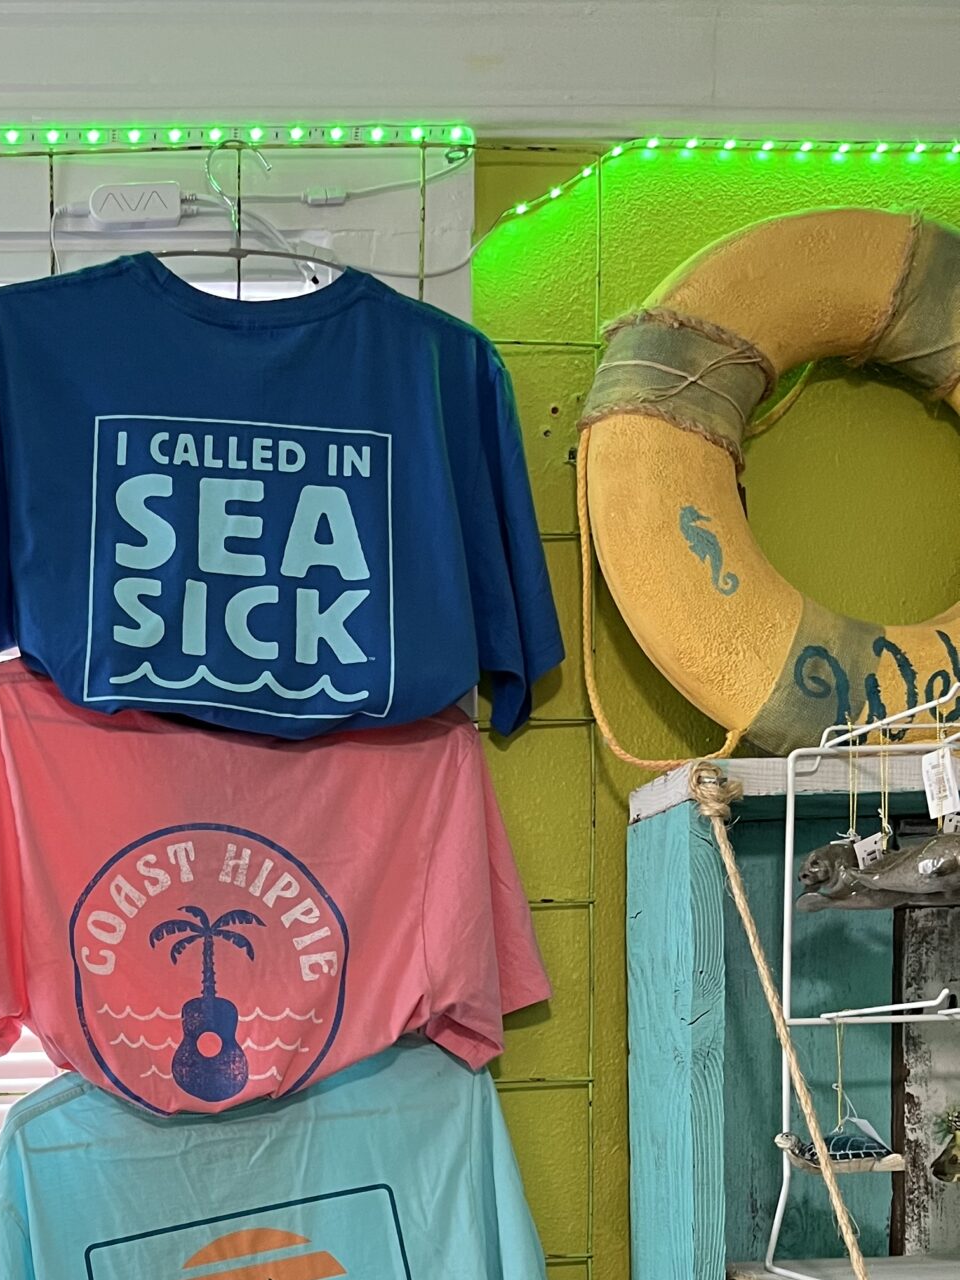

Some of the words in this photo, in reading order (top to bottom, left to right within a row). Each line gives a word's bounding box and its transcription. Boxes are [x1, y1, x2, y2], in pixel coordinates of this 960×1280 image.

[116, 431, 128, 466] I
[149, 432, 306, 473] CALLED
[328, 444, 371, 478] IN
[115, 473, 371, 580] SEA
[113, 577, 371, 665] SICK
[81, 840, 195, 976] COAST
[218, 843, 338, 982] HIPPIE
